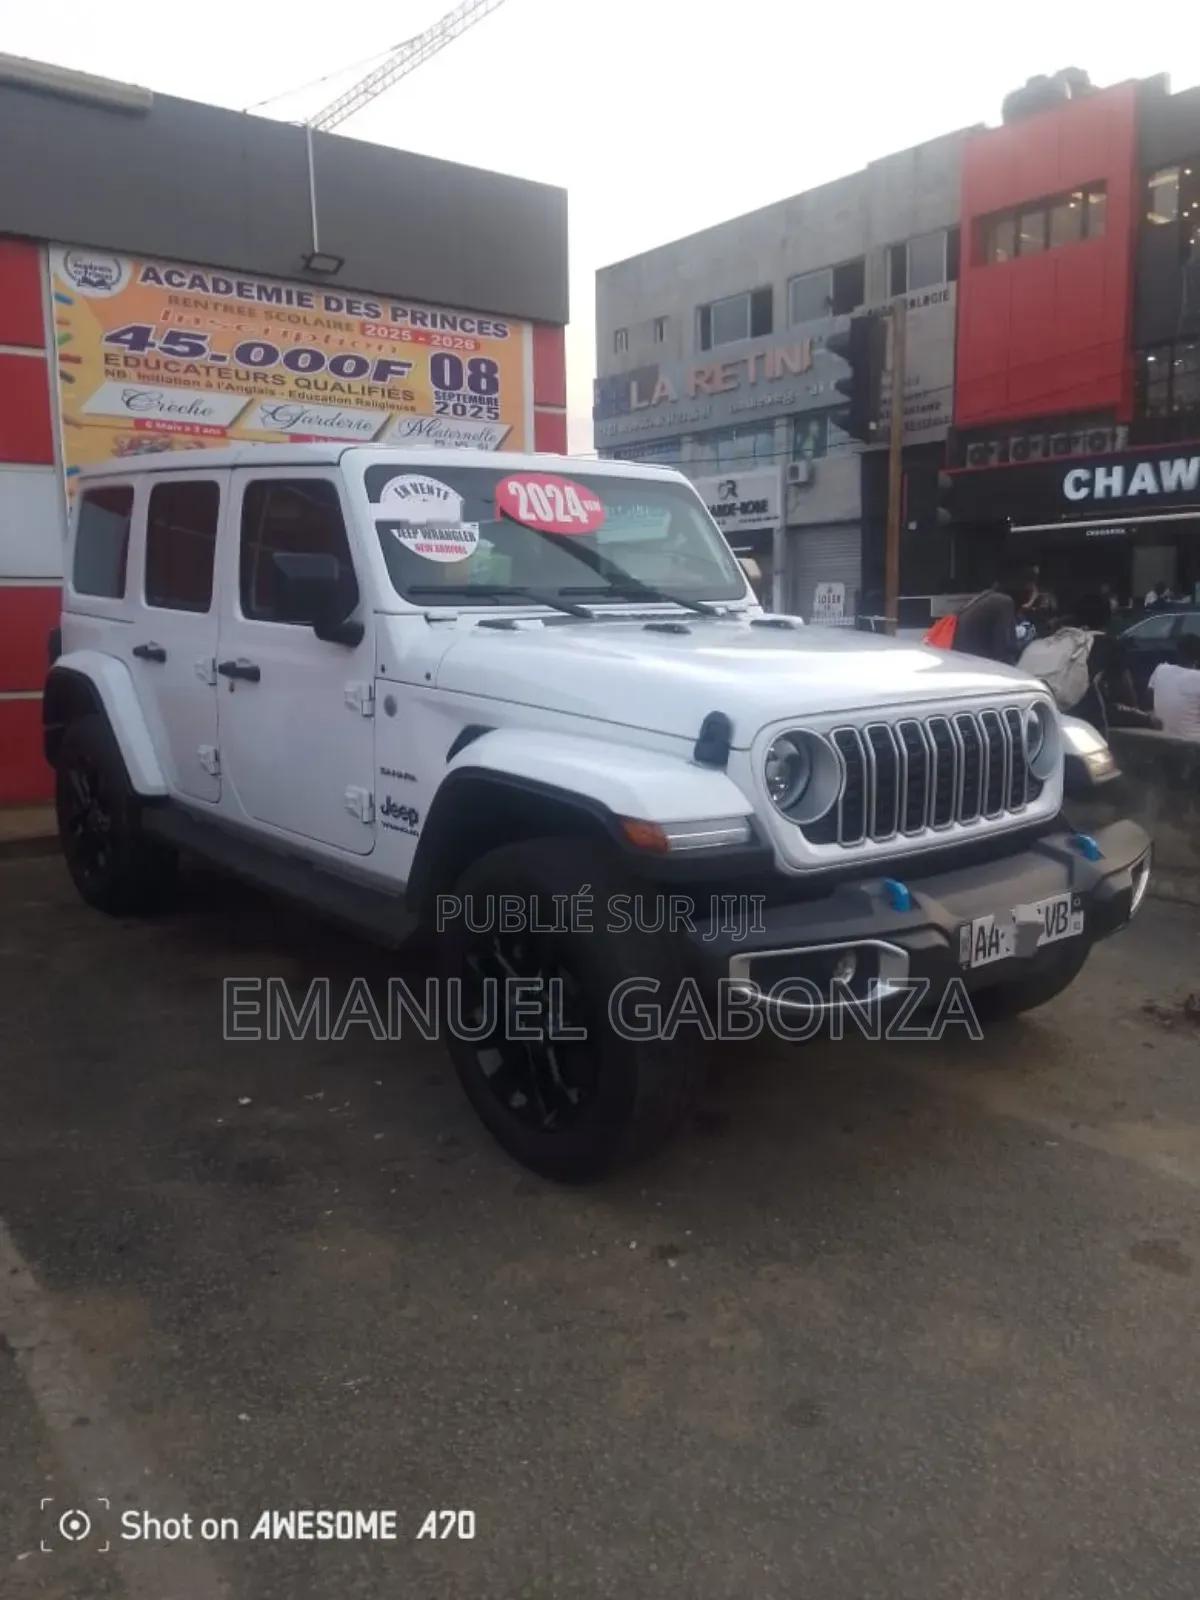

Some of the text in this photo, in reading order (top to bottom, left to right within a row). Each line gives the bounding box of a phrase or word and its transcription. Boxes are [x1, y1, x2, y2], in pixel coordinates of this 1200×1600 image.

[139, 265, 509, 338] ACADEMIE DES PRINCES
[263, 309, 355, 332] SCOLAIRE
[365, 324, 412, 341] 2025
[431, 335, 475, 350] 2026
[104, 353, 286, 386] EDUCATEURS
[137, 371, 200, 387] Initiation
[205, 377, 213, 389] à
[430, 352, 499, 395] 08
[434, 390, 499, 407] SEPTEMBRE
[629, 372, 677, 412] LA
[259, 402, 373, 431] Garderie
[435, 401, 499, 421] 2025
[399, 419, 497, 443] Maternelle
[507, 481, 589, 525] 2024
[419, 528, 477, 543] WRANGLER
[380, 795, 420, 827] Jeep
